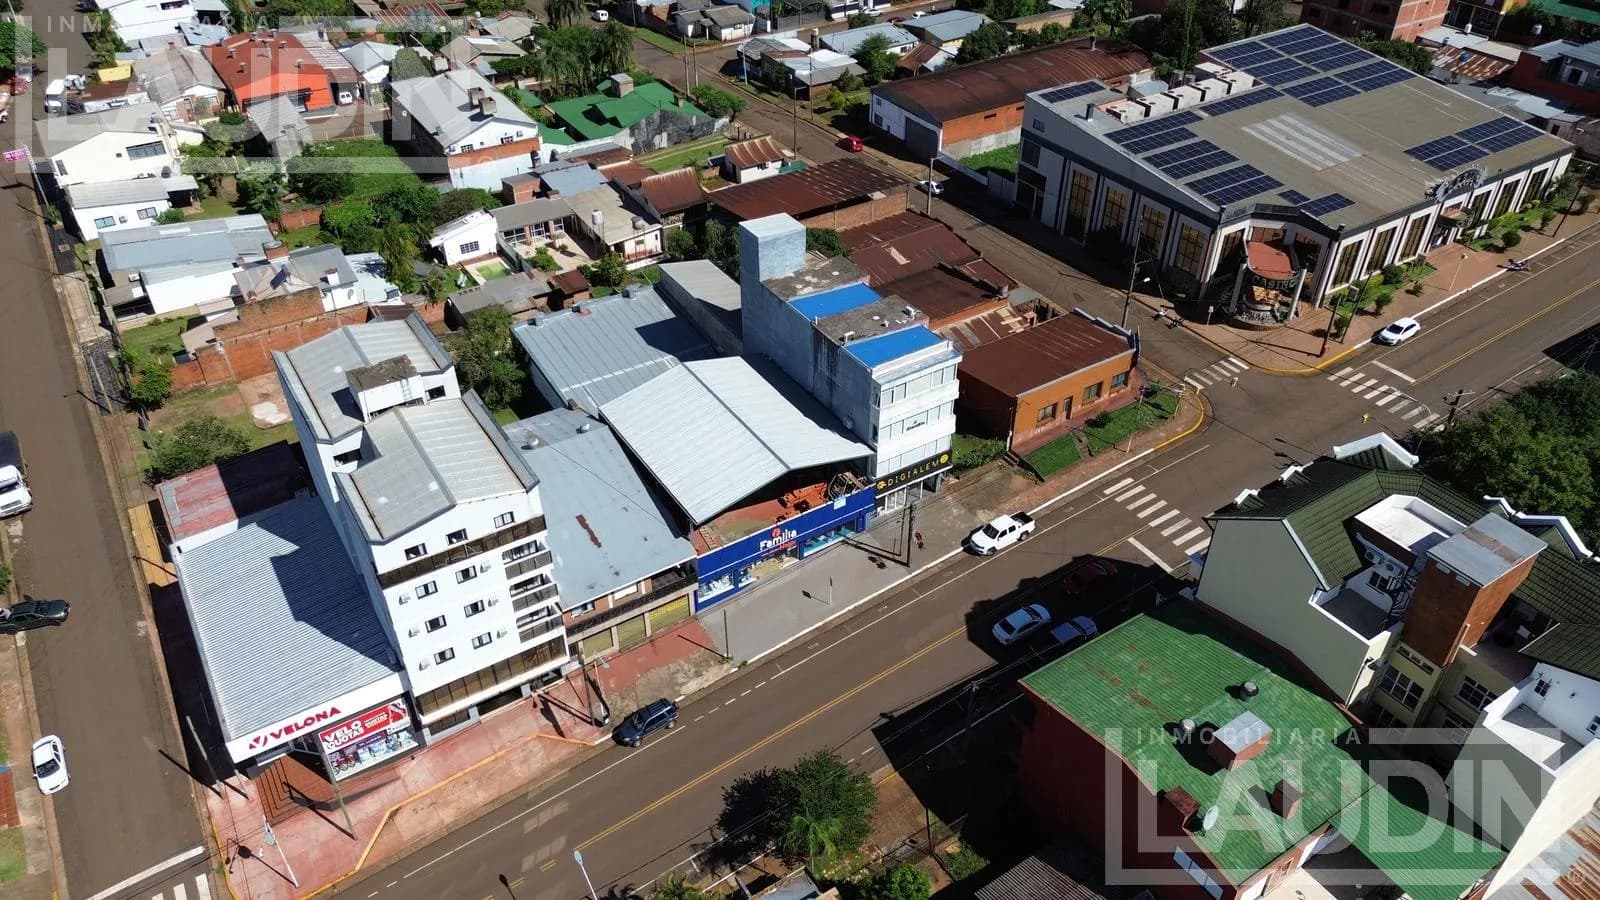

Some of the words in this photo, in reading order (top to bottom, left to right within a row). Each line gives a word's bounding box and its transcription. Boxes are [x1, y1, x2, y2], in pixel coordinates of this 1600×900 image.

[270, 706, 342, 739] VELONA
[324, 720, 362, 743] VELO
[326, 726, 365, 749] CUOTAS
